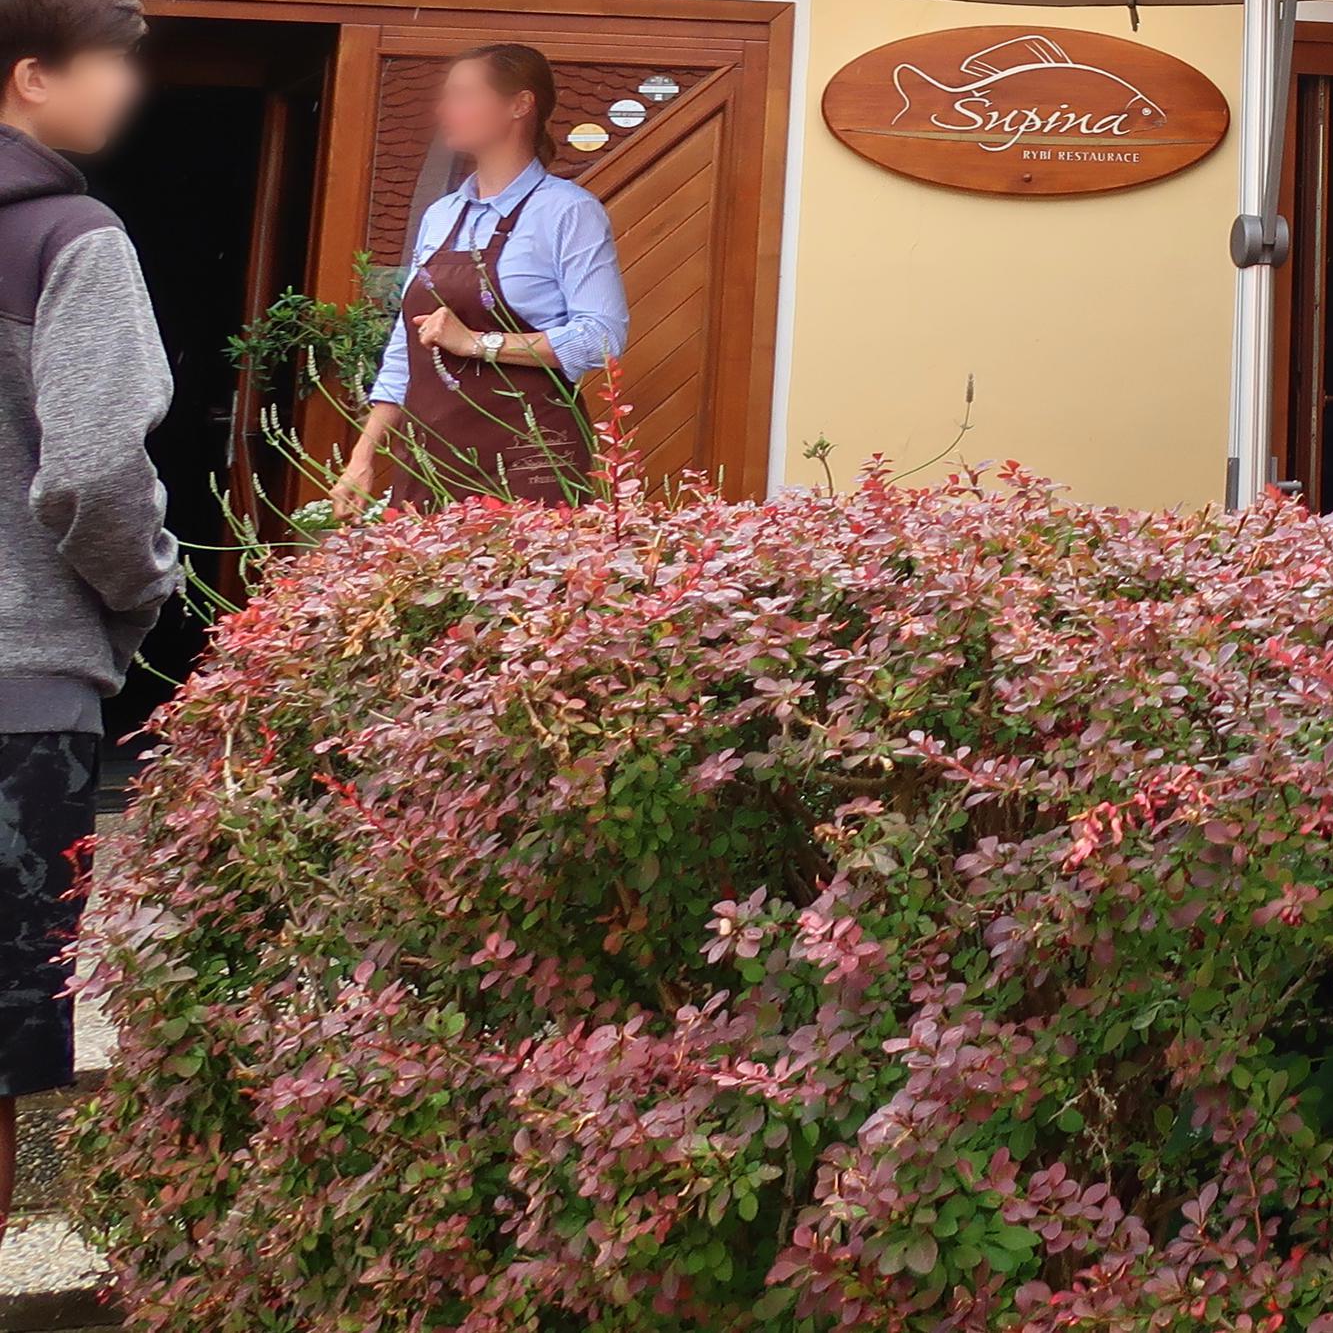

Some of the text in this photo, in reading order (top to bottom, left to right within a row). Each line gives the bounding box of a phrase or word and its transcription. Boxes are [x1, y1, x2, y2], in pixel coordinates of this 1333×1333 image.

[930, 90, 1131, 151] Šupina
[1022, 149, 1140, 163] RYBÍ RESTAURACE
